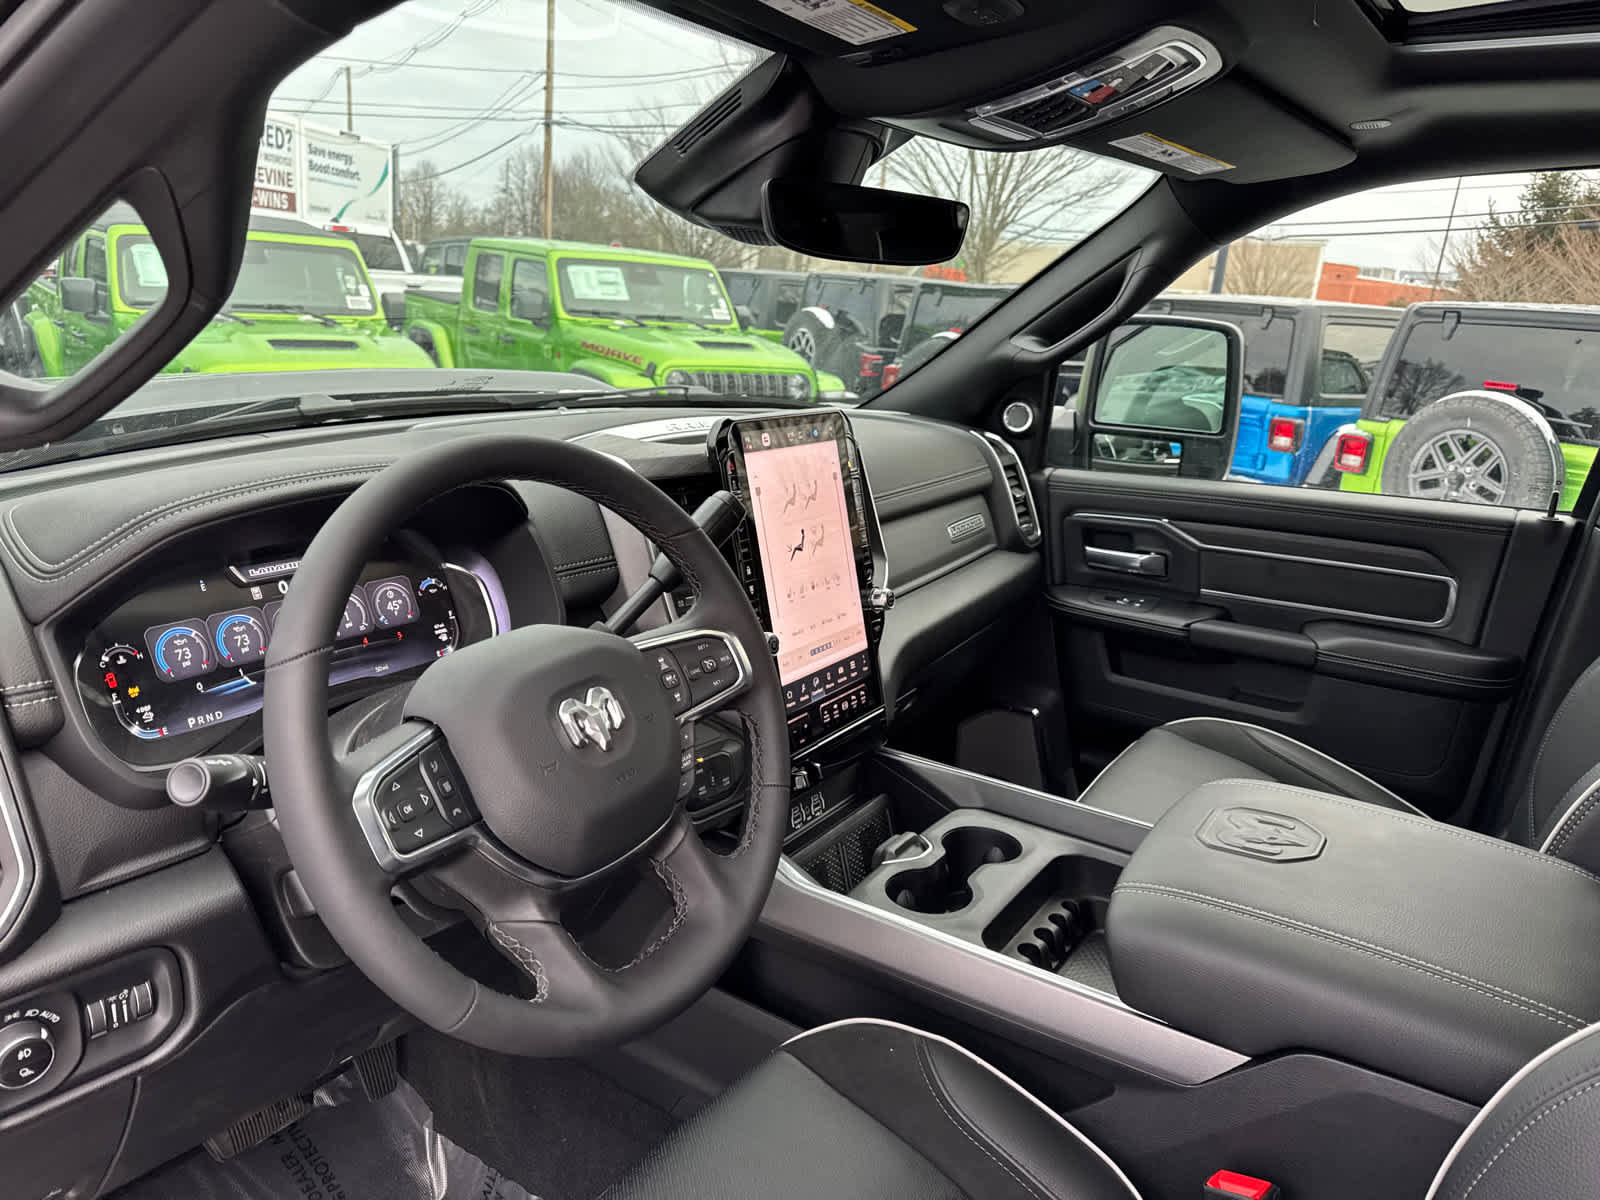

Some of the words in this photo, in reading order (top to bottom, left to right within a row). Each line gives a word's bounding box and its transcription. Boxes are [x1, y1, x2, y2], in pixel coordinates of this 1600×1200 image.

[262, 124, 293, 152] ED?
[308, 143, 326, 158] Save
[256, 166, 293, 188] EVINE
[581, 340, 644, 366] MOJAVE
[248, 561, 302, 577] LARAMI
[234, 634, 250, 647] 73
[174, 647, 192, 661] 73
[40, 1010, 61, 1024] AUTO
